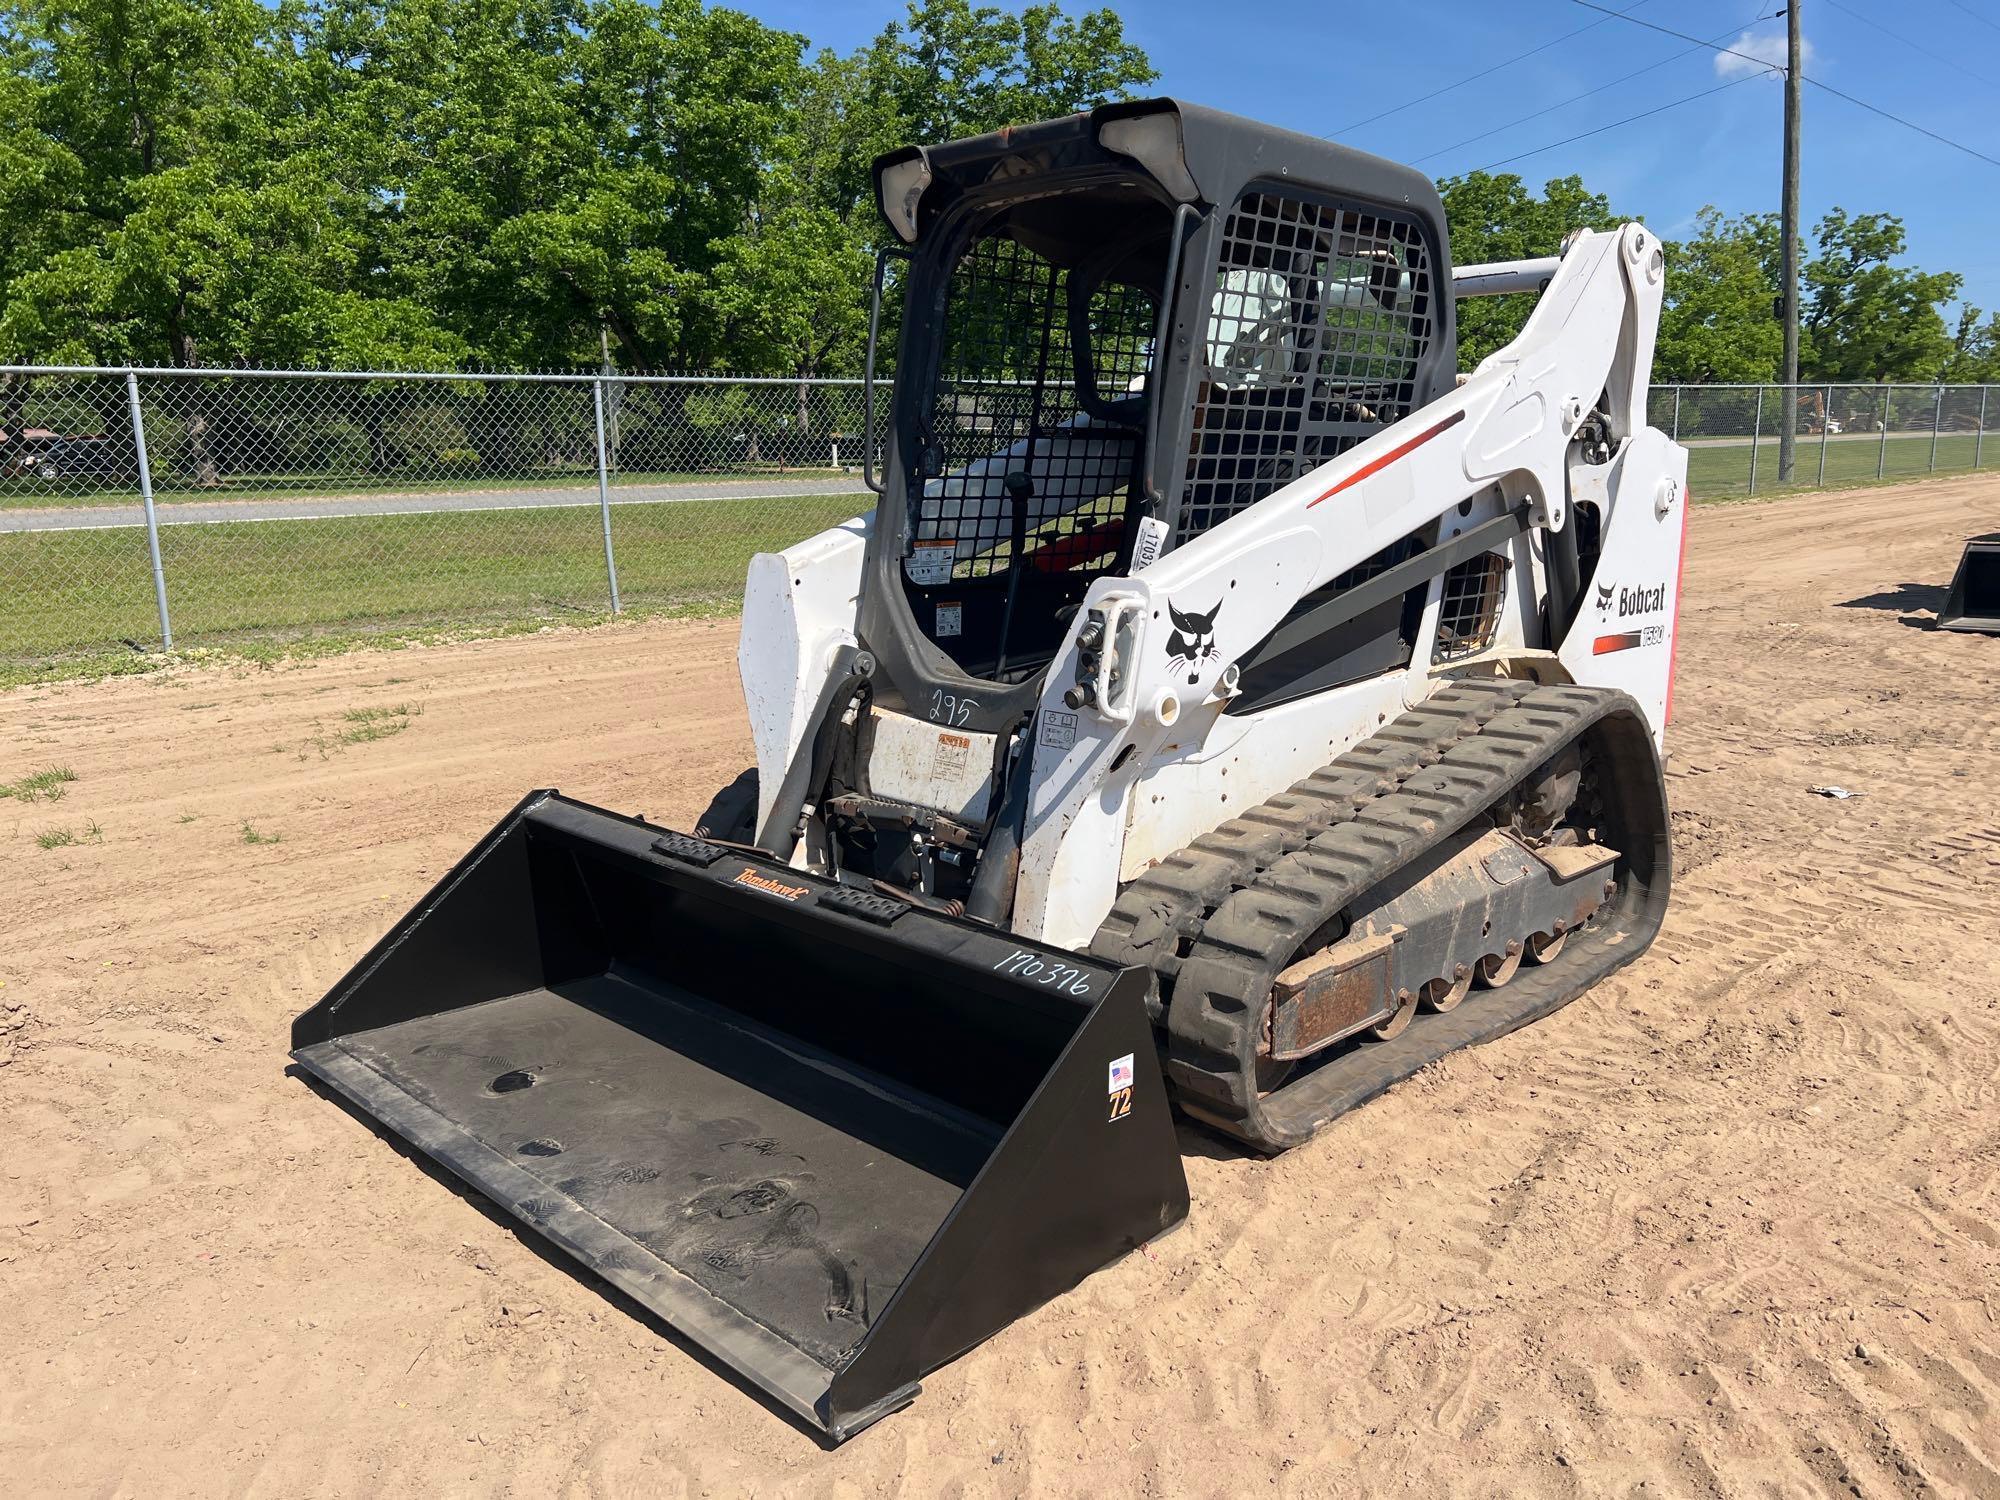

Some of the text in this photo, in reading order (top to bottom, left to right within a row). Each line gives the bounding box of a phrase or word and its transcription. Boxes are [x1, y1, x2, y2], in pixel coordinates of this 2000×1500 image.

[1619, 583, 1665, 617] Bobcat
[929, 689, 980, 727] 295
[733, 868, 809, 899] Tomahawk
[993, 950, 1090, 995] 170376
